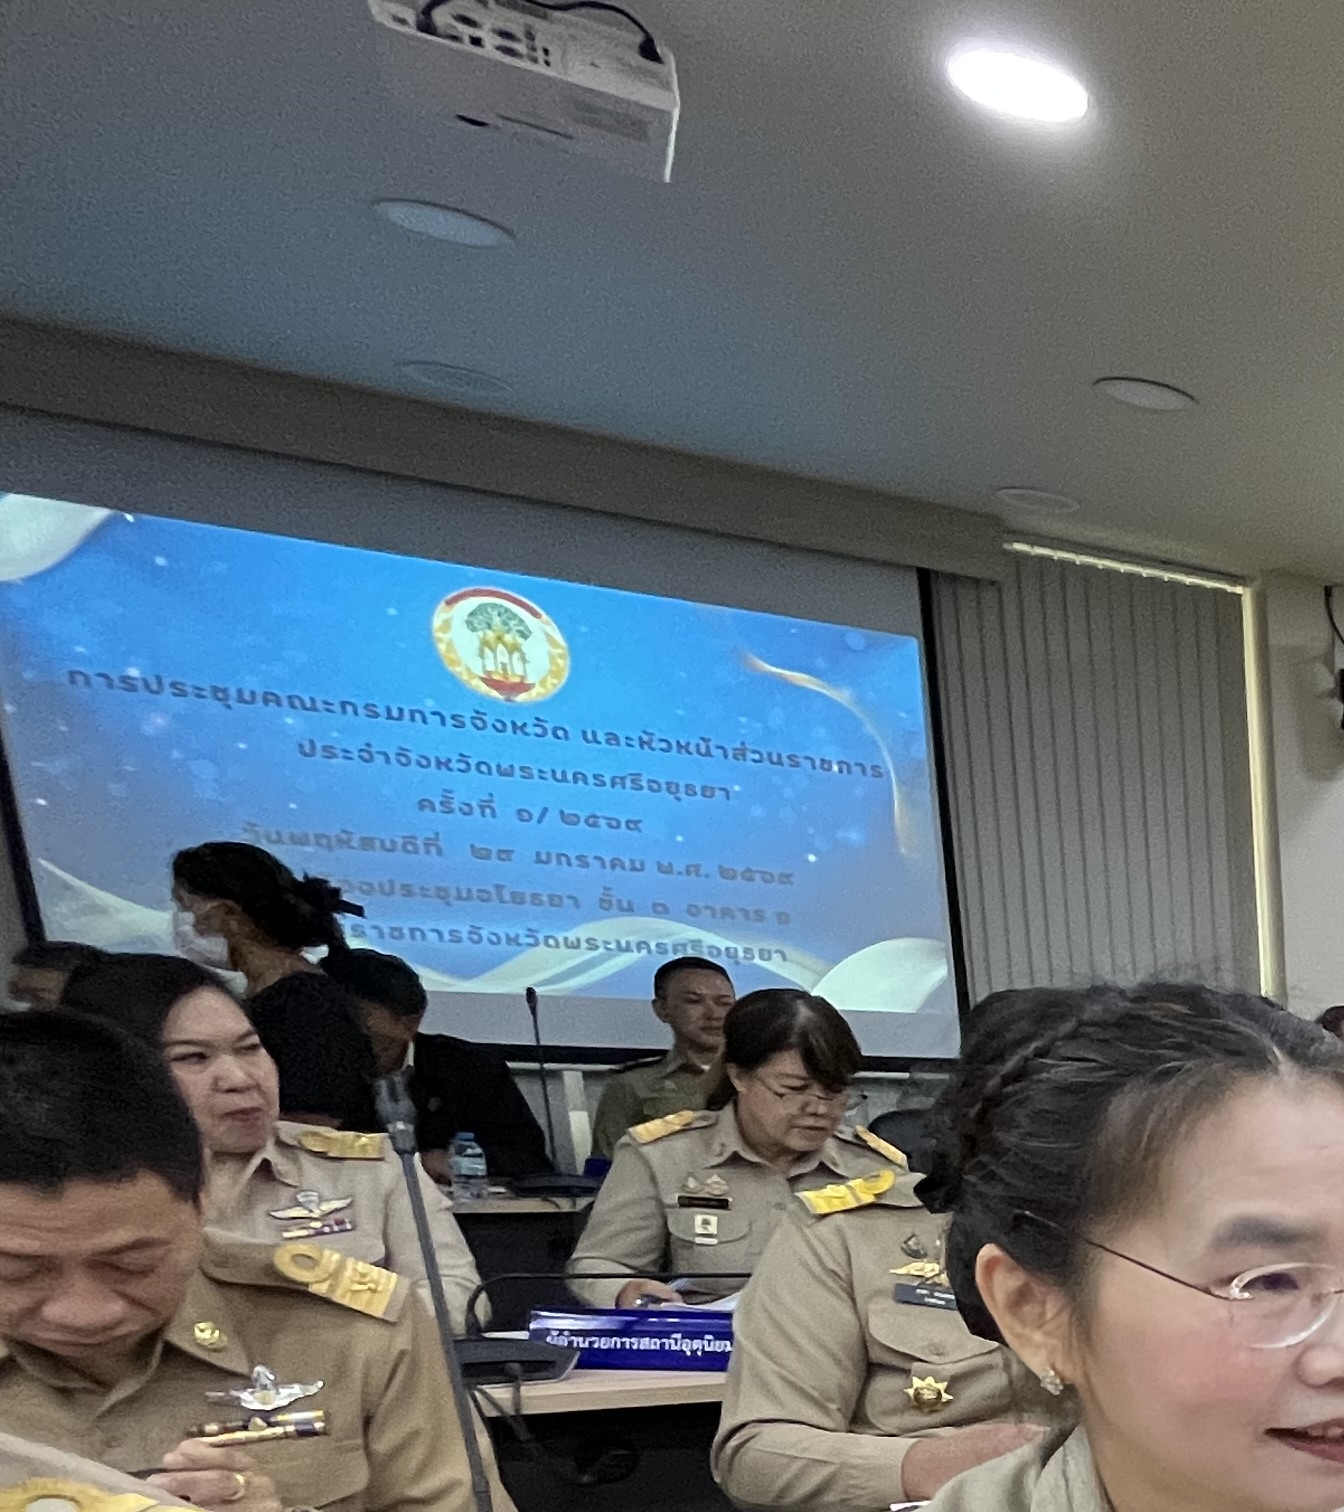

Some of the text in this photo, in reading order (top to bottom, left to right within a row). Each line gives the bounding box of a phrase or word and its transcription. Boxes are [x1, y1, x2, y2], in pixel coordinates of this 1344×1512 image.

[350, 922, 788, 966] ราชการจังหวัดพระนครศรีอยุธยา
